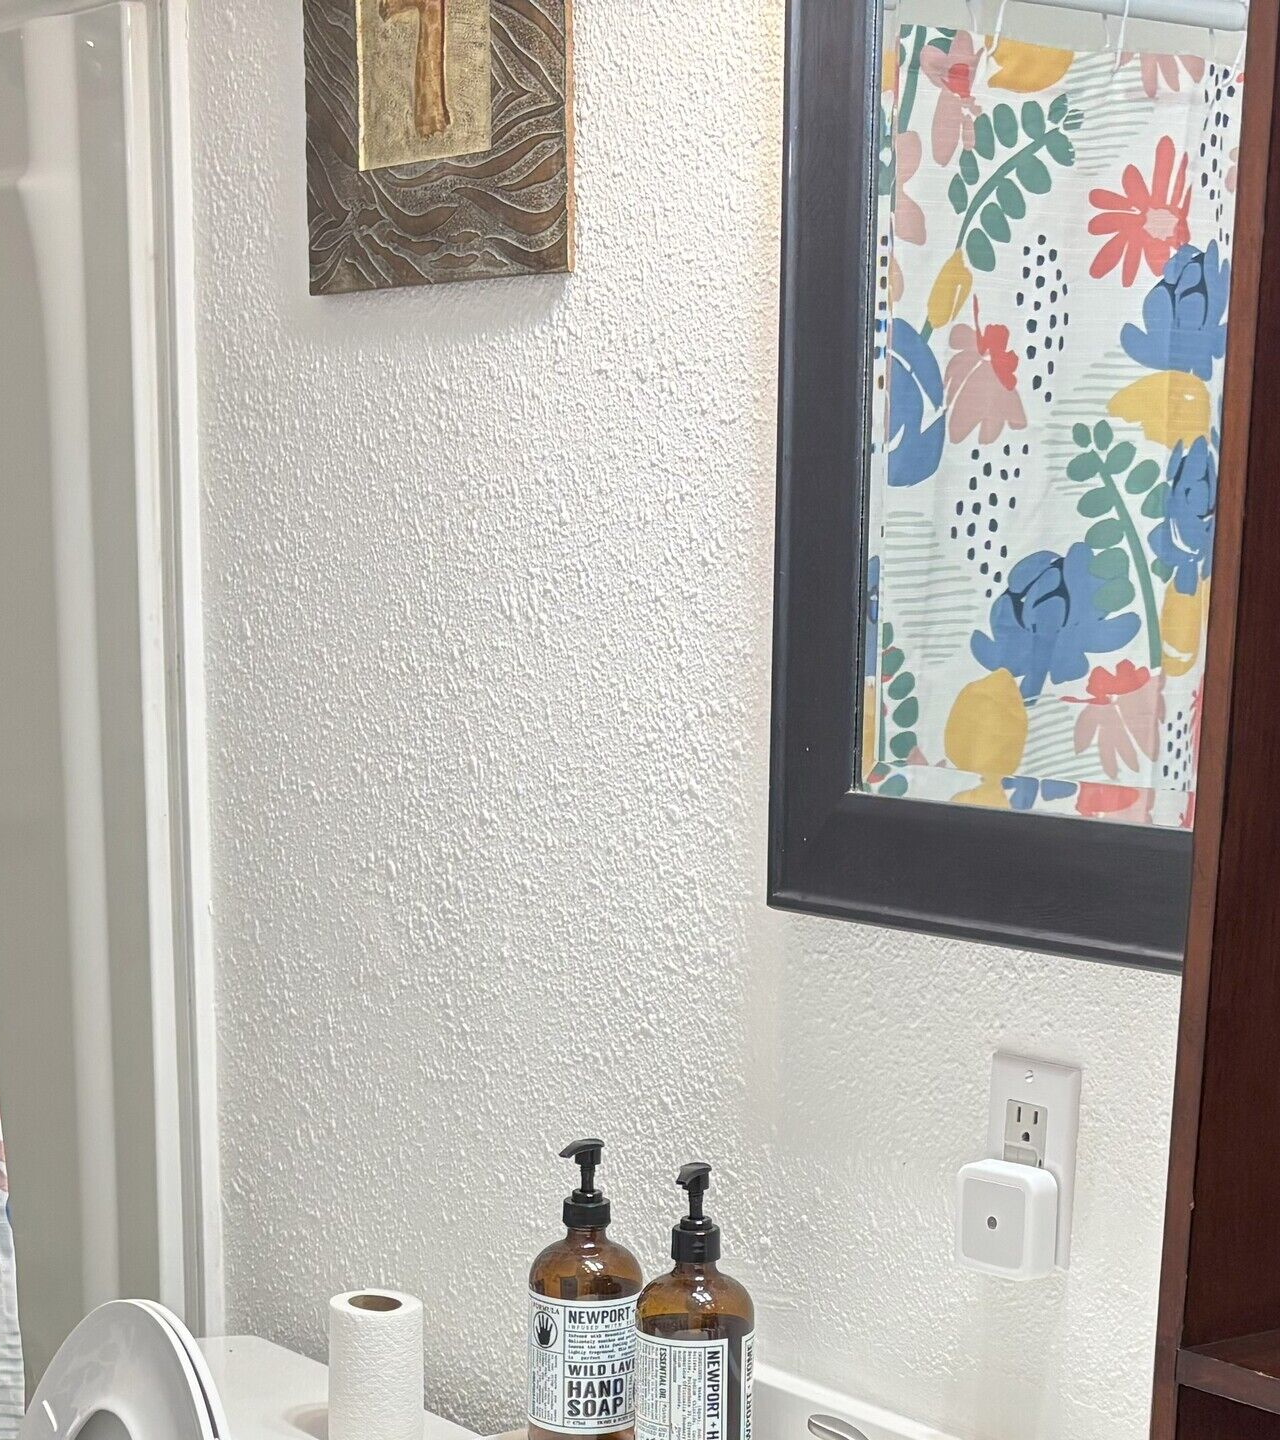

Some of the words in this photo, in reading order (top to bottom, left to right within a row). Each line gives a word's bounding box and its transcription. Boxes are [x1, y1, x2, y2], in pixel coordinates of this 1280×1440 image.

[568, 1306, 630, 1324] NEWPORT
[568, 1364, 606, 1376] WILD
[568, 1378, 624, 1398] HAND
[706, 1350, 720, 1419] NEWPORT
[567, 1397, 623, 1417] SOAP
